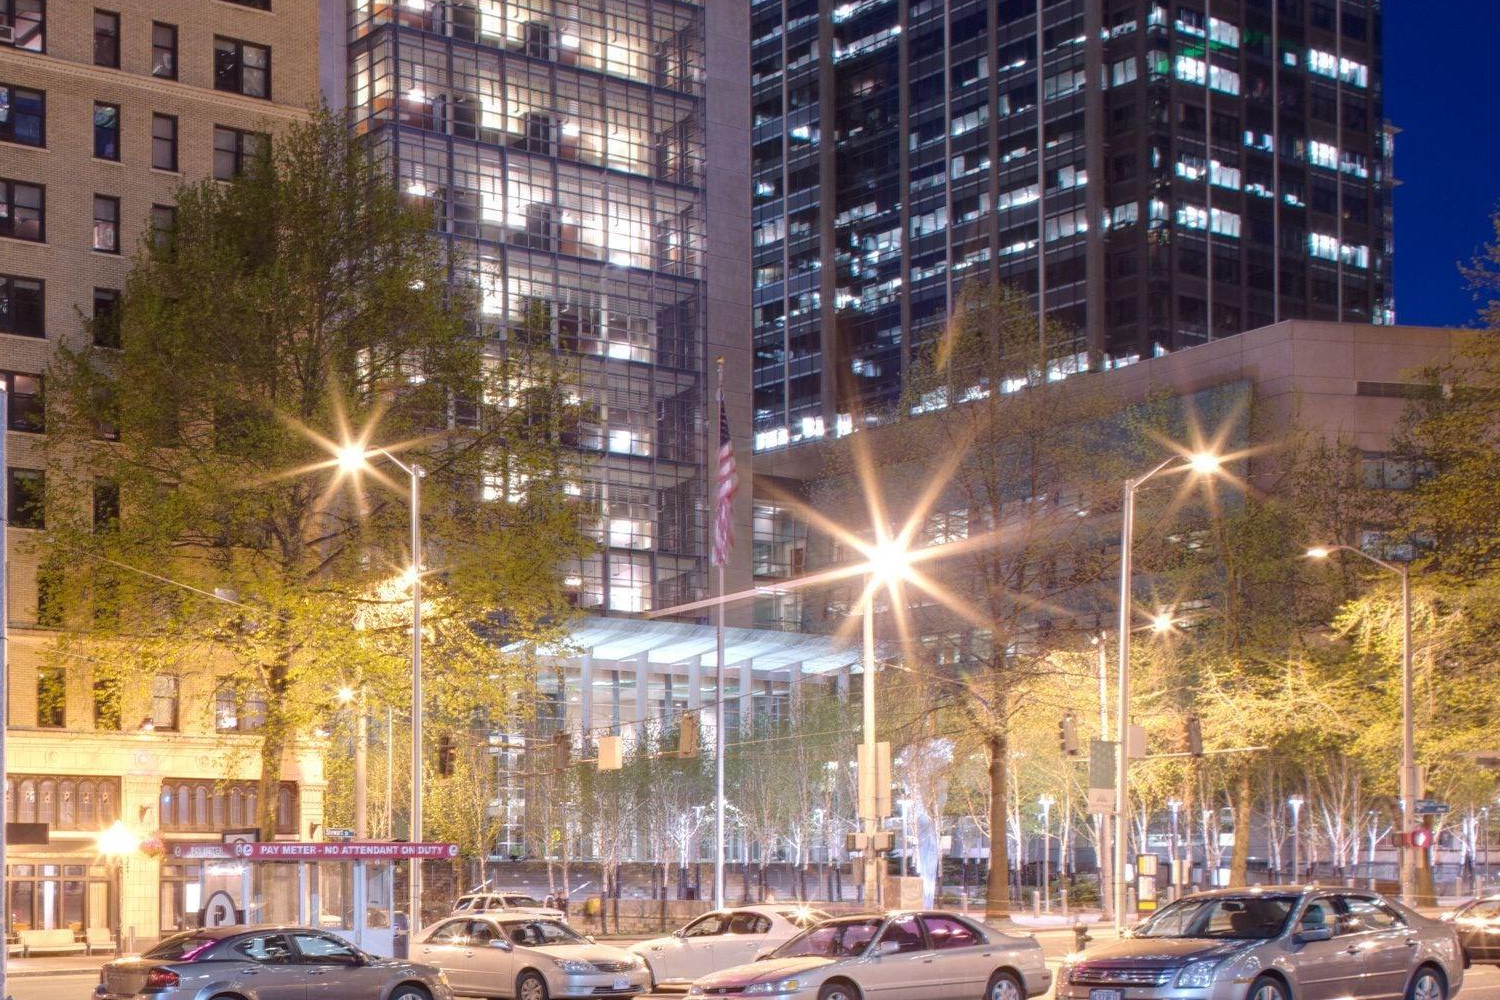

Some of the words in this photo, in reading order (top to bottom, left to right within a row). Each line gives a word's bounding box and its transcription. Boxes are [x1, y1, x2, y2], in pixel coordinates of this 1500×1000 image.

[260, 845, 279, 855] PAY
[282, 845, 316, 855] METER
[324, 845, 339, 855] NO
[342, 845, 399, 855] ATTENDANT
[401, 845, 415, 855] ON
[417, 845, 444, 855] DUTY
